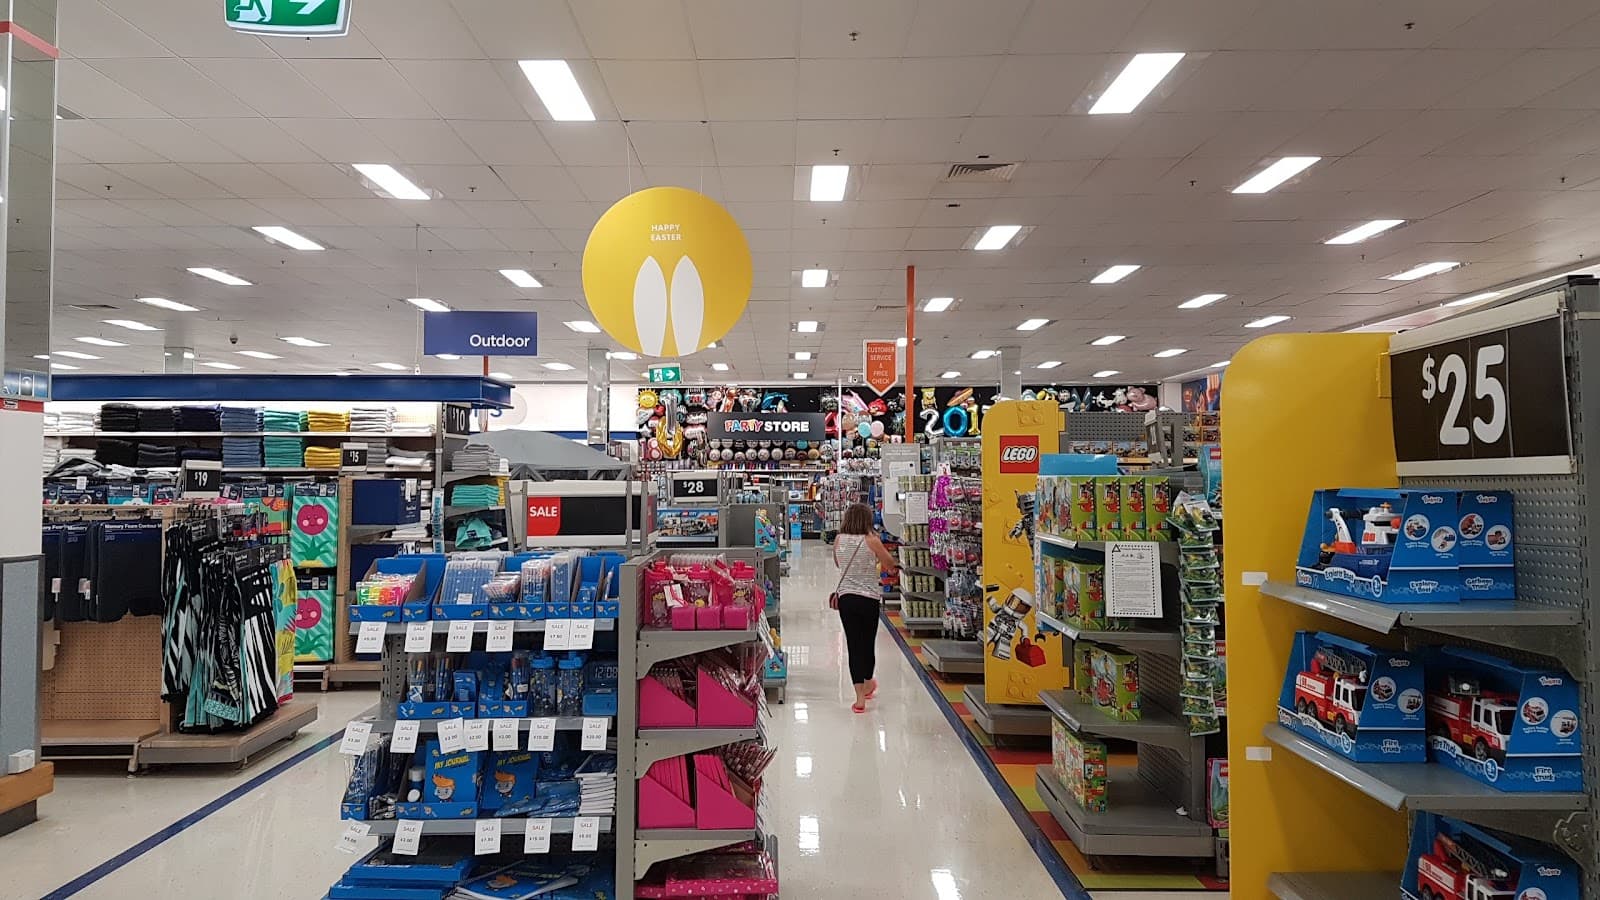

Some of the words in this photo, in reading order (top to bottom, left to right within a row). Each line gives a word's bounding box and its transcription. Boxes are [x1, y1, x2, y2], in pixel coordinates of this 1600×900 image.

[650, 233, 681, 241] EASTER
[469, 333, 530, 349] Outdoor
[1421, 343, 1507, 446] $25
[724, 418, 763, 433] PARTY
[763, 420, 810, 432] STORE
[350, 451, 359, 464] $15
[1002, 446, 1037, 462] LEGO
[194, 471, 208, 487] $19
[682, 480, 705, 494] $28
[529, 506, 558, 517] SALE
